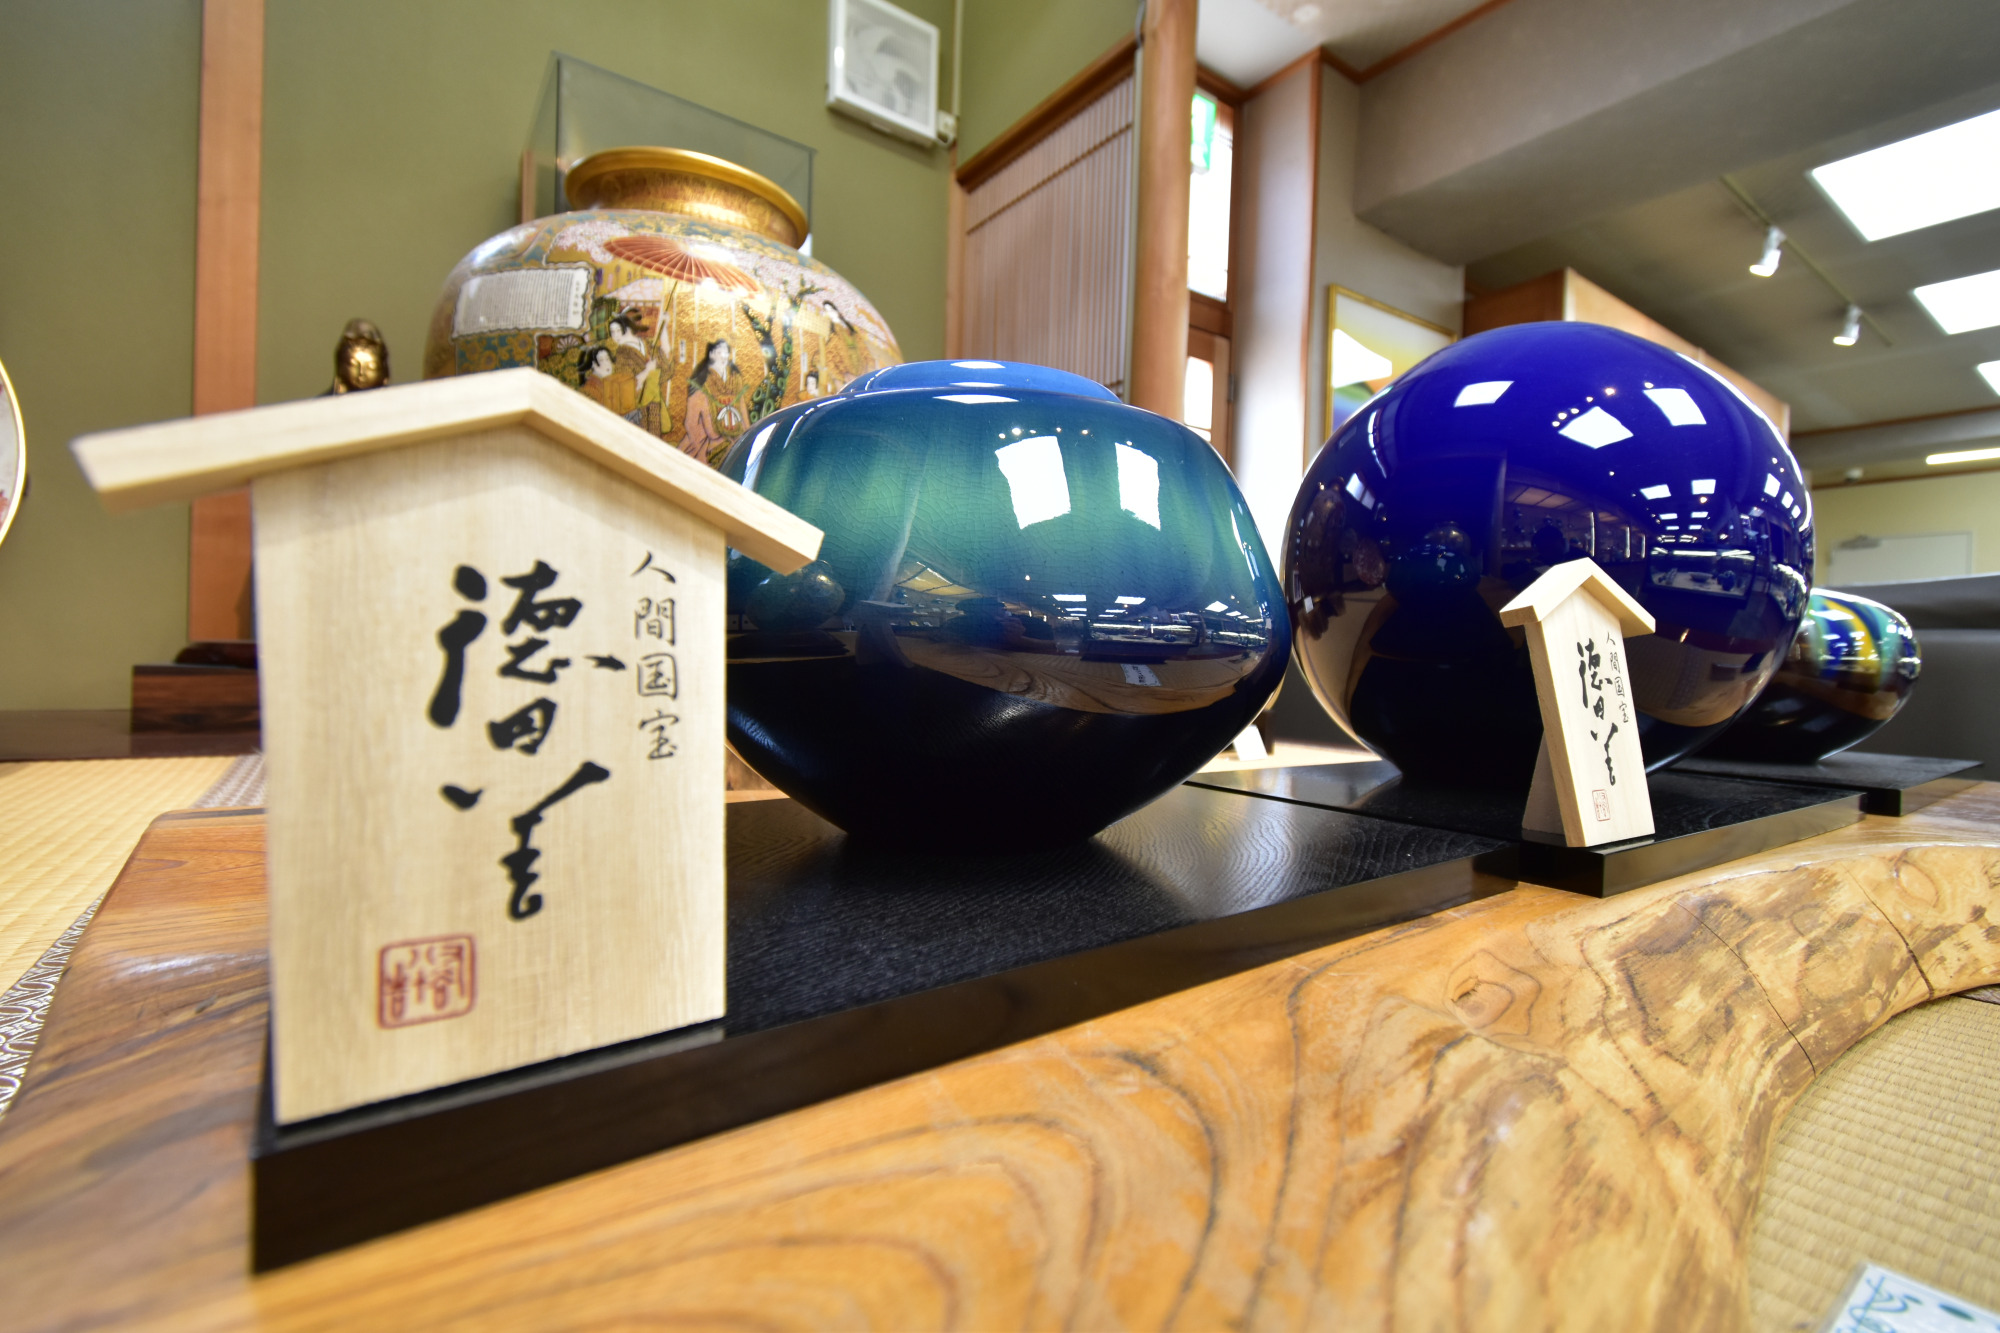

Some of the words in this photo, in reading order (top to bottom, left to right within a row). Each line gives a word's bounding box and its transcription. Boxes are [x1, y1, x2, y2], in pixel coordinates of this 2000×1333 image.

[631, 551, 679, 761] 人間国宝
[1606, 632, 1629, 723] 人間国宝
